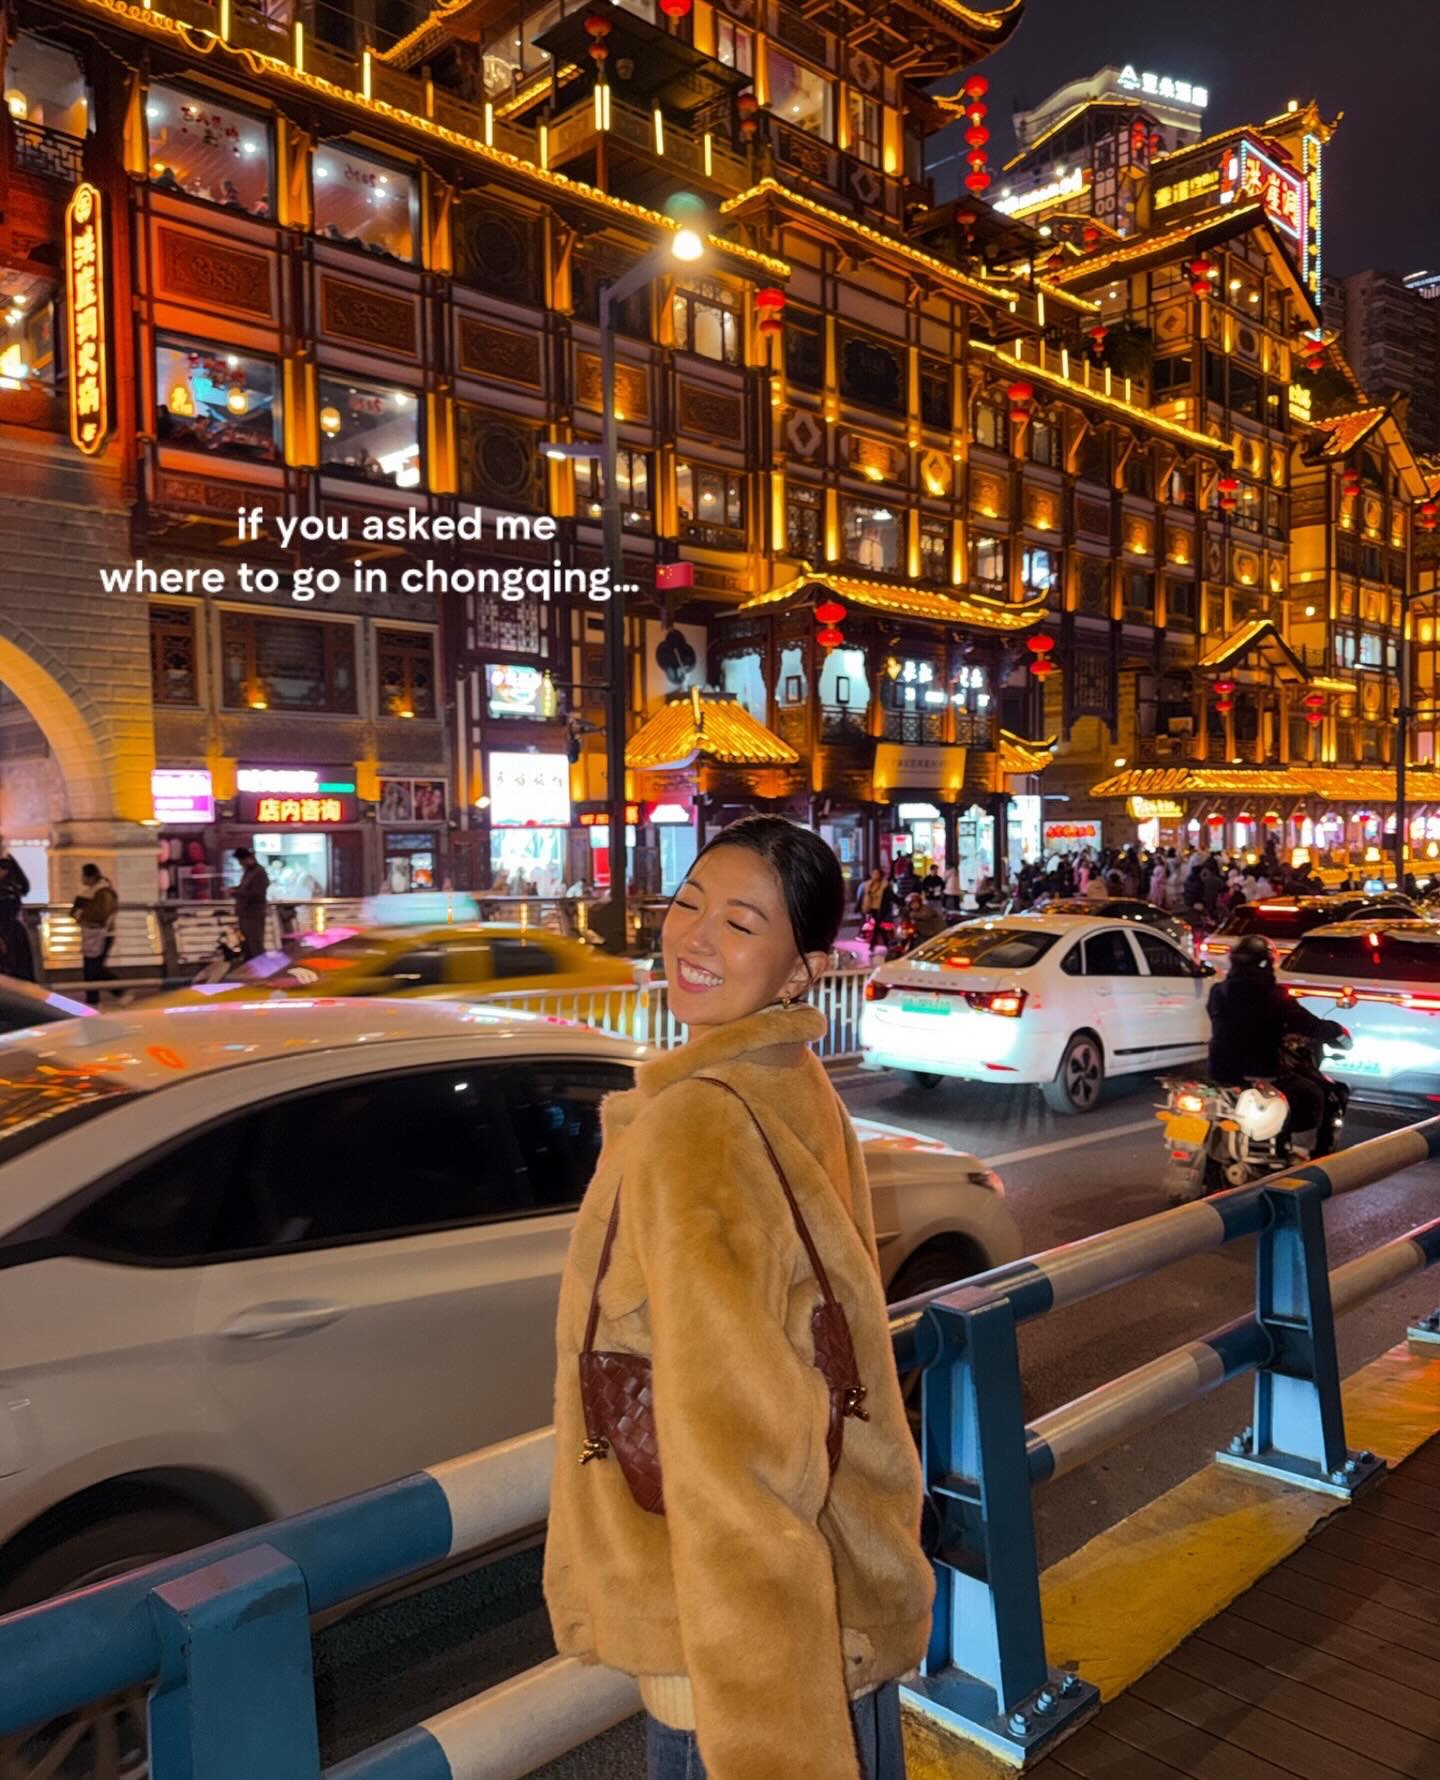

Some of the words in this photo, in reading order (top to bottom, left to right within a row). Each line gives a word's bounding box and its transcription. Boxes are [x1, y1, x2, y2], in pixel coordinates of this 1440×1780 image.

[1244, 157, 1299, 228] 洪崖洞
[257, 798, 343, 822] 店内咨询
